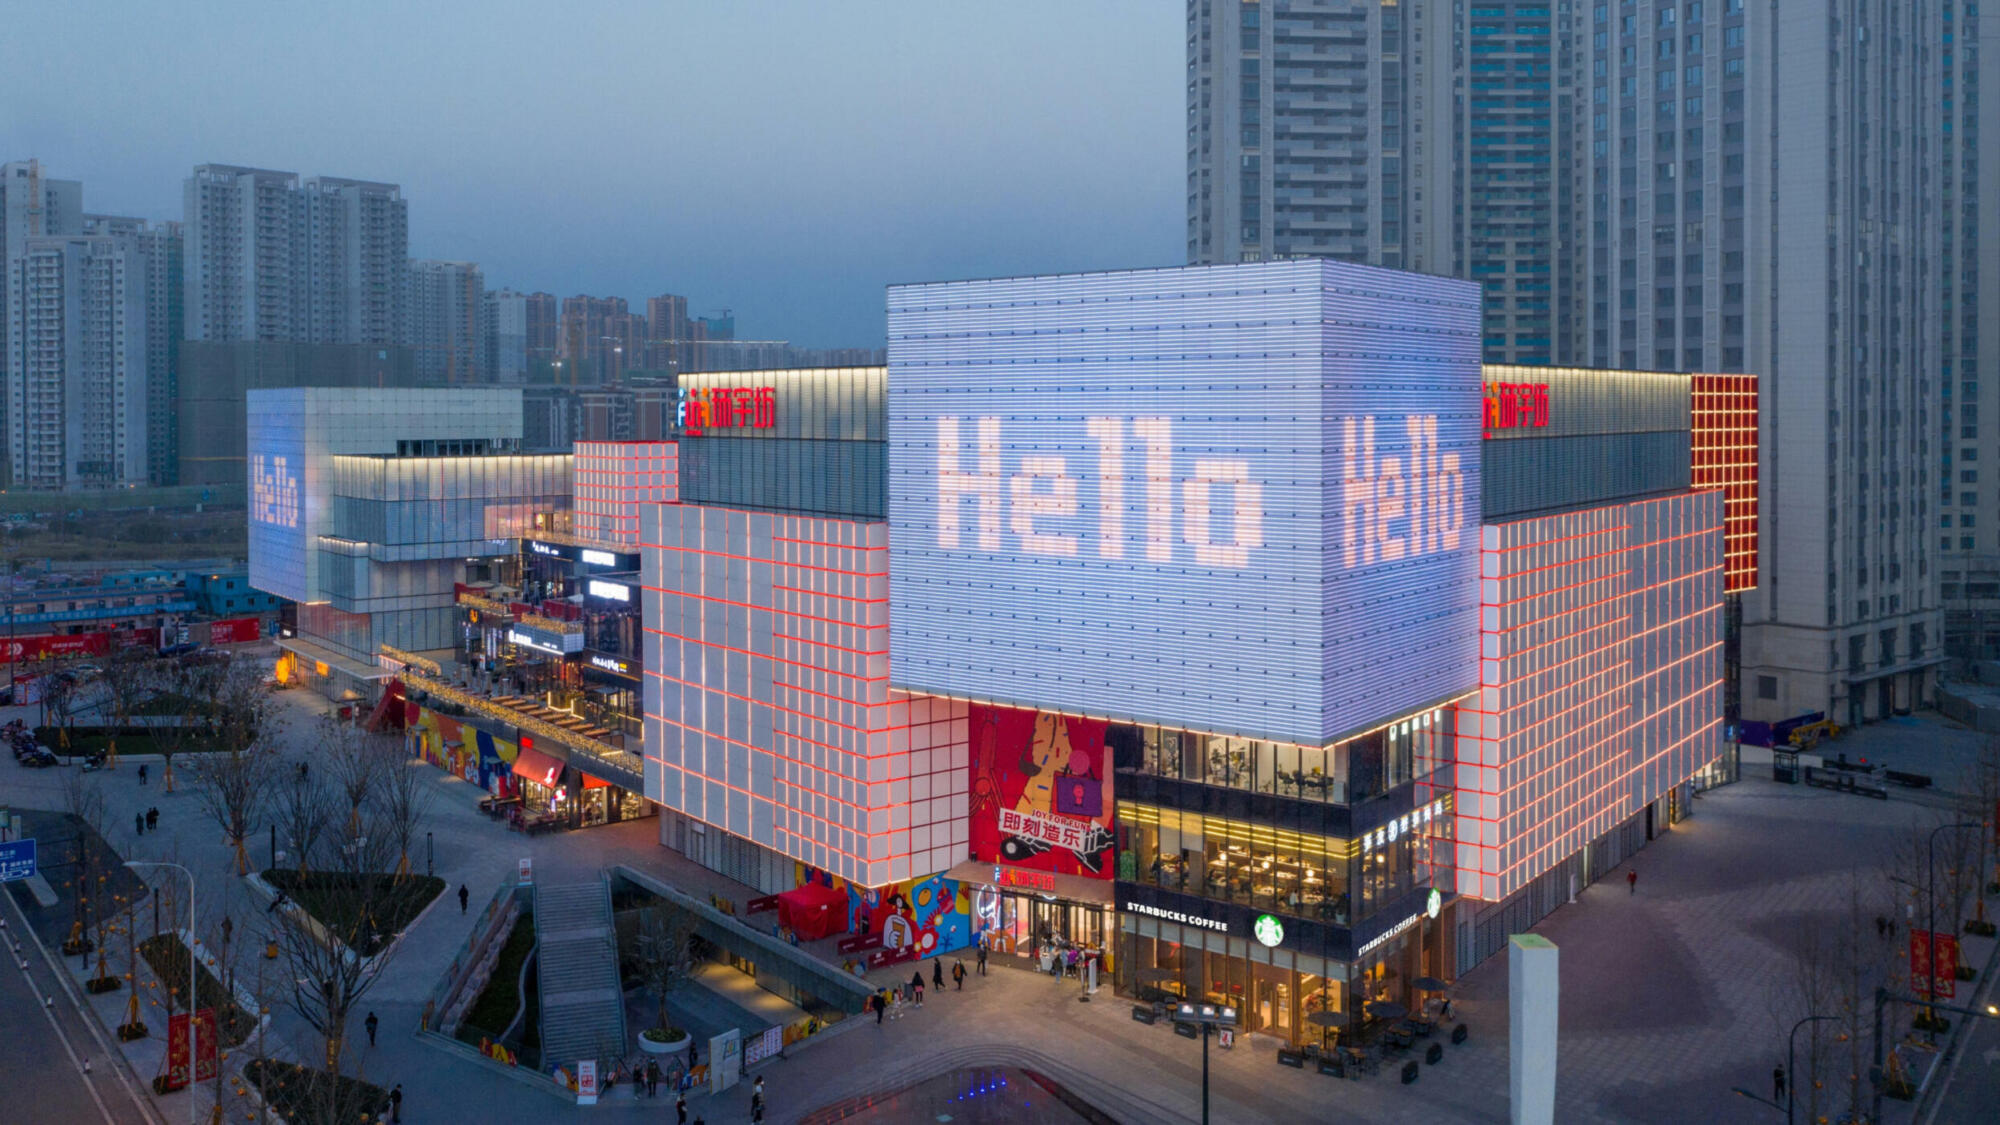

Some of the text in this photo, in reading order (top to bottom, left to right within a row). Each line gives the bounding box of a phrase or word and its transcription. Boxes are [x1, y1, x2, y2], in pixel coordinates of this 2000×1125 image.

[253, 455, 298, 528] Hello
[937, 416, 1262, 568] Hello
[1344, 415, 1463, 568] Hello
[1003, 812, 1080, 848] 即刻造乐
[1032, 809, 1047, 819] JOY
[1049, 813, 1066, 825] FOR
[1127, 902, 1228, 932] STARBUCKS COFFEE
[1357, 913, 1418, 957] STARBUCKS COFFEE
